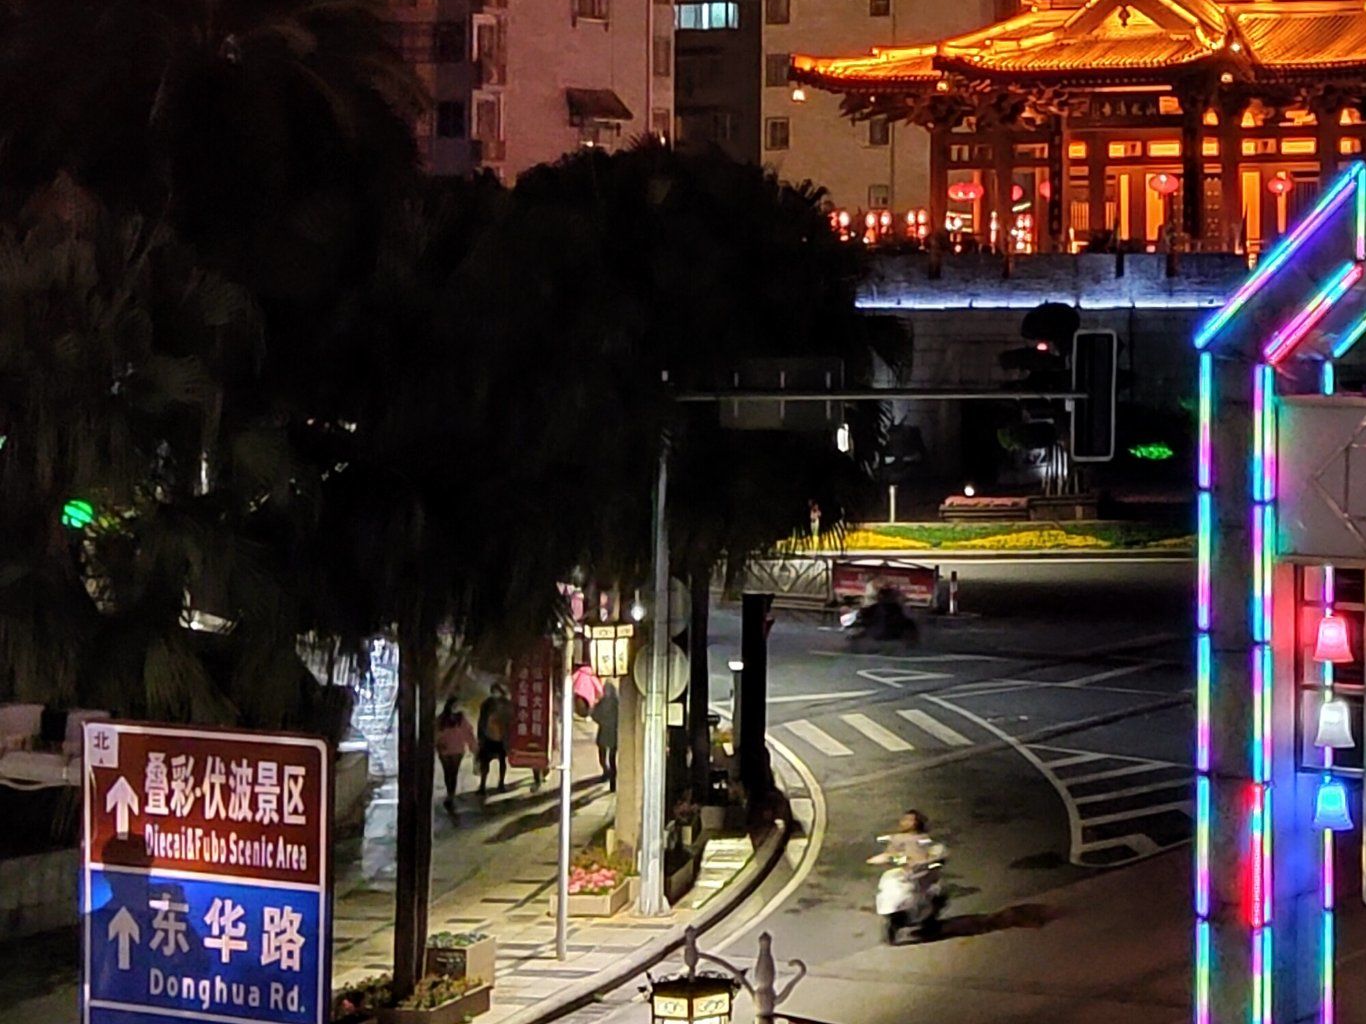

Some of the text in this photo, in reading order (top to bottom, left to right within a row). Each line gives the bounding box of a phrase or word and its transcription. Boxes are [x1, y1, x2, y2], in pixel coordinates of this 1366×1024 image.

[93, 731, 110, 750] 北
[229, 831, 274, 868] Scenic
[276, 835, 307, 871] Area
[149, 892, 306, 972] 东华路
[150, 967, 306, 1013] Donghua Rd.
